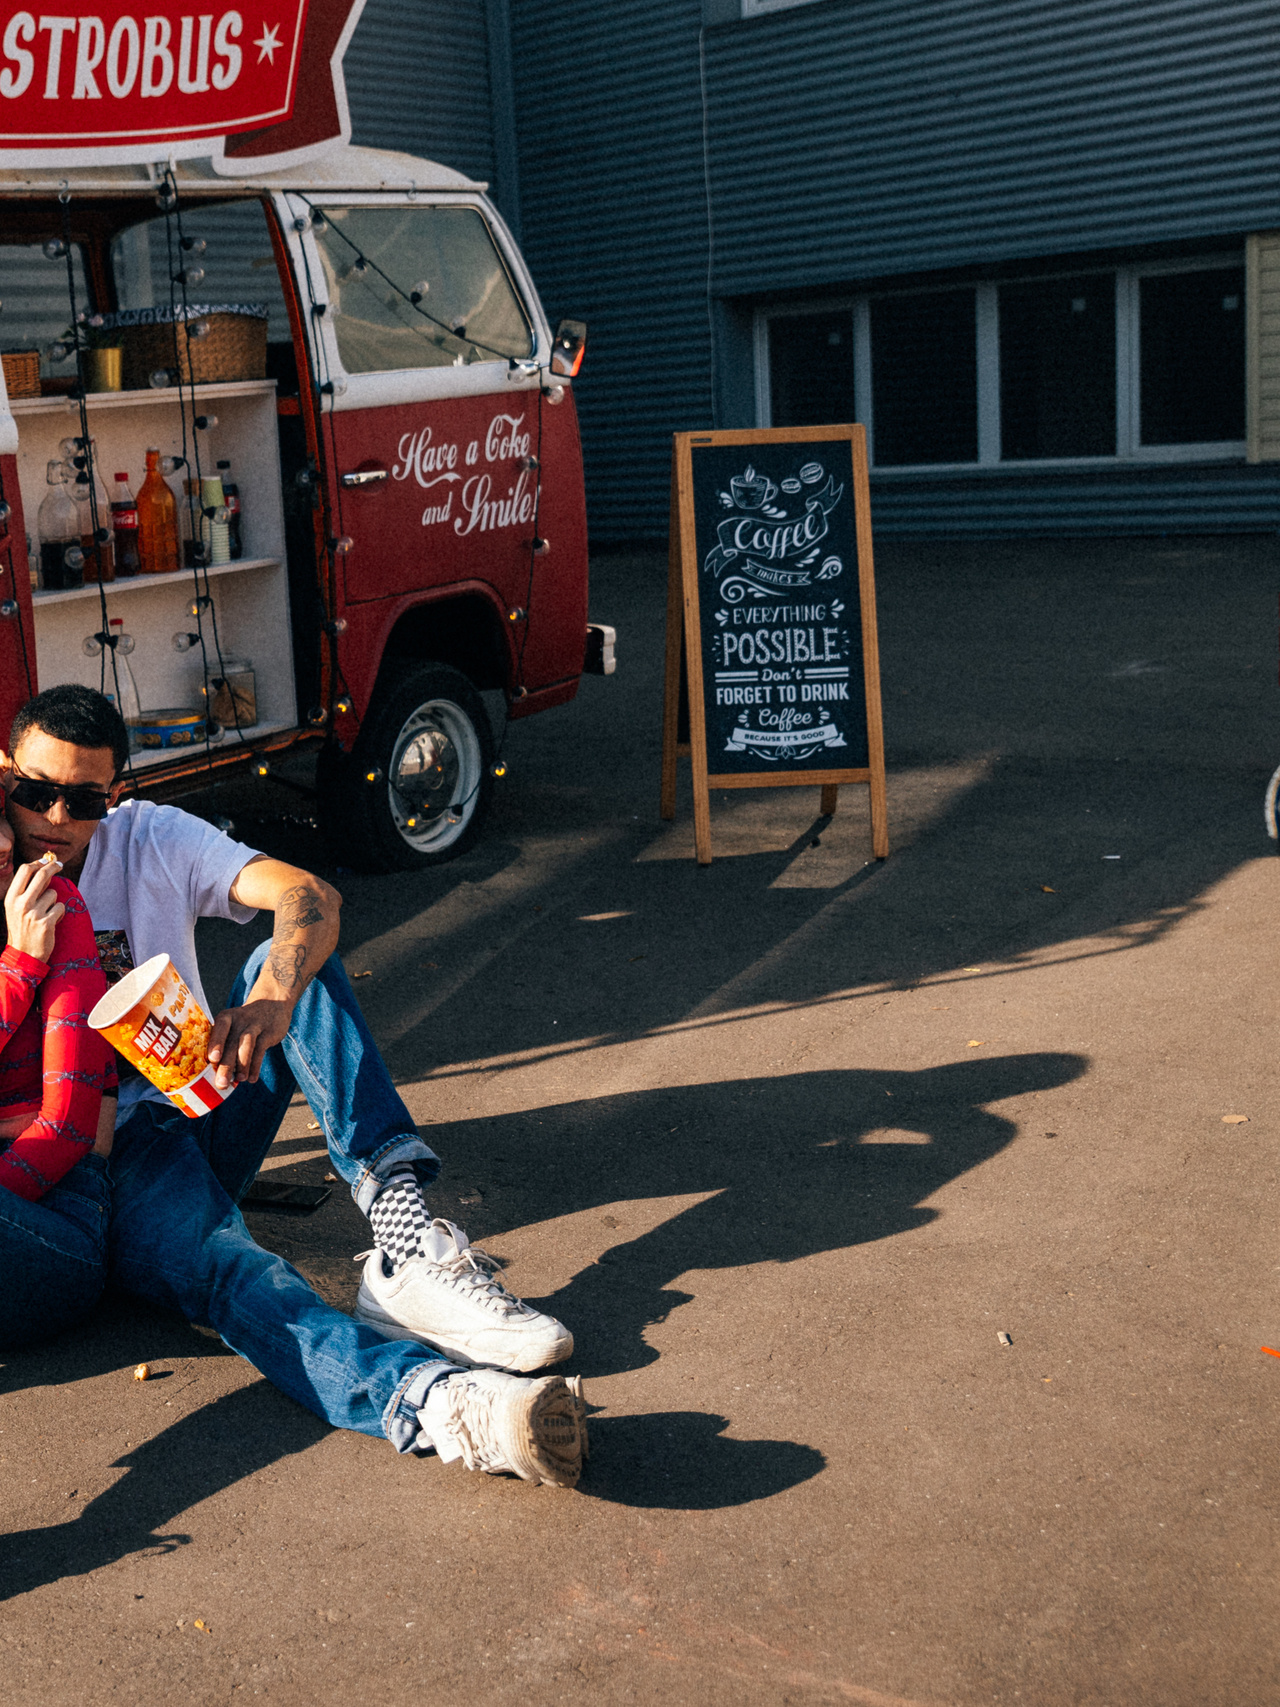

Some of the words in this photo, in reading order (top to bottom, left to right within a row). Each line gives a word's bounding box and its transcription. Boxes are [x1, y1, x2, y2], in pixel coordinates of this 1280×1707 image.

[392, 427, 462, 489] Have
[465, 440, 479, 466] a
[485, 412, 530, 463] Coke
[422, 491, 453, 526] and
[454, 470, 542, 537] Smile!
[734, 514, 820, 560] Coffee
[757, 568, 794, 584] makes
[733, 604, 827, 625] EVERYTHING
[723, 627, 841, 667] POSSIBLE
[761, 667, 802, 682] Don't
[716, 686, 772, 705] FORGET
[776, 685, 797, 703] TO
[801, 682, 850, 702] DRINK
[758, 707, 813, 731] Coffee
[744, 733, 782, 742] BECAUSE
[801, 731, 825, 741] GOOD
[133, 1018, 162, 1053] MIX
[152, 1025, 179, 1060] BAR
